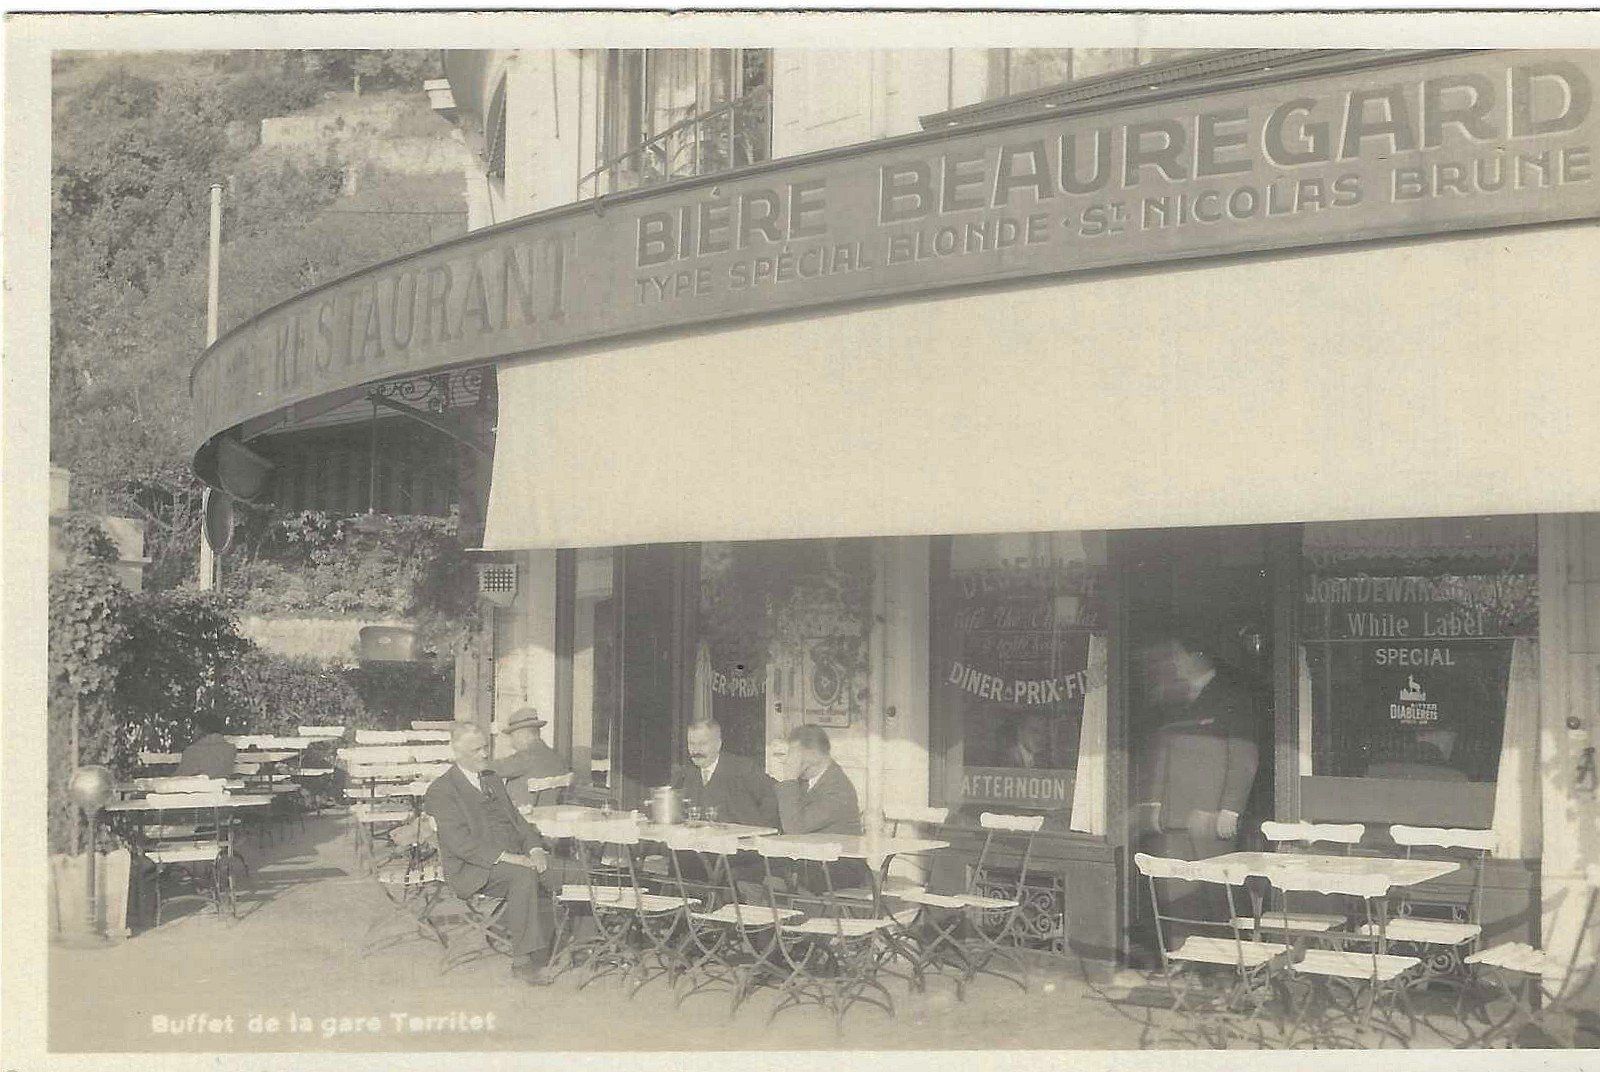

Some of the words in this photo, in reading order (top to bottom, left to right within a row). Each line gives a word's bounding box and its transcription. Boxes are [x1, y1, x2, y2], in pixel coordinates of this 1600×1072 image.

[878, 60, 1593, 226] BEAUREGARD
[635, 268, 713, 306] TYPE
[887, 212, 1049, 266] BLONDE
[1141, 172, 1363, 231] NICOLAS
[1392, 146, 1594, 203] BRUNE
[1348, 612, 1410, 637] White
[1424, 610, 1485, 637] Label
[1376, 648, 1456, 666] SPECIAL
[961, 773, 1064, 801] AFTERNOON
